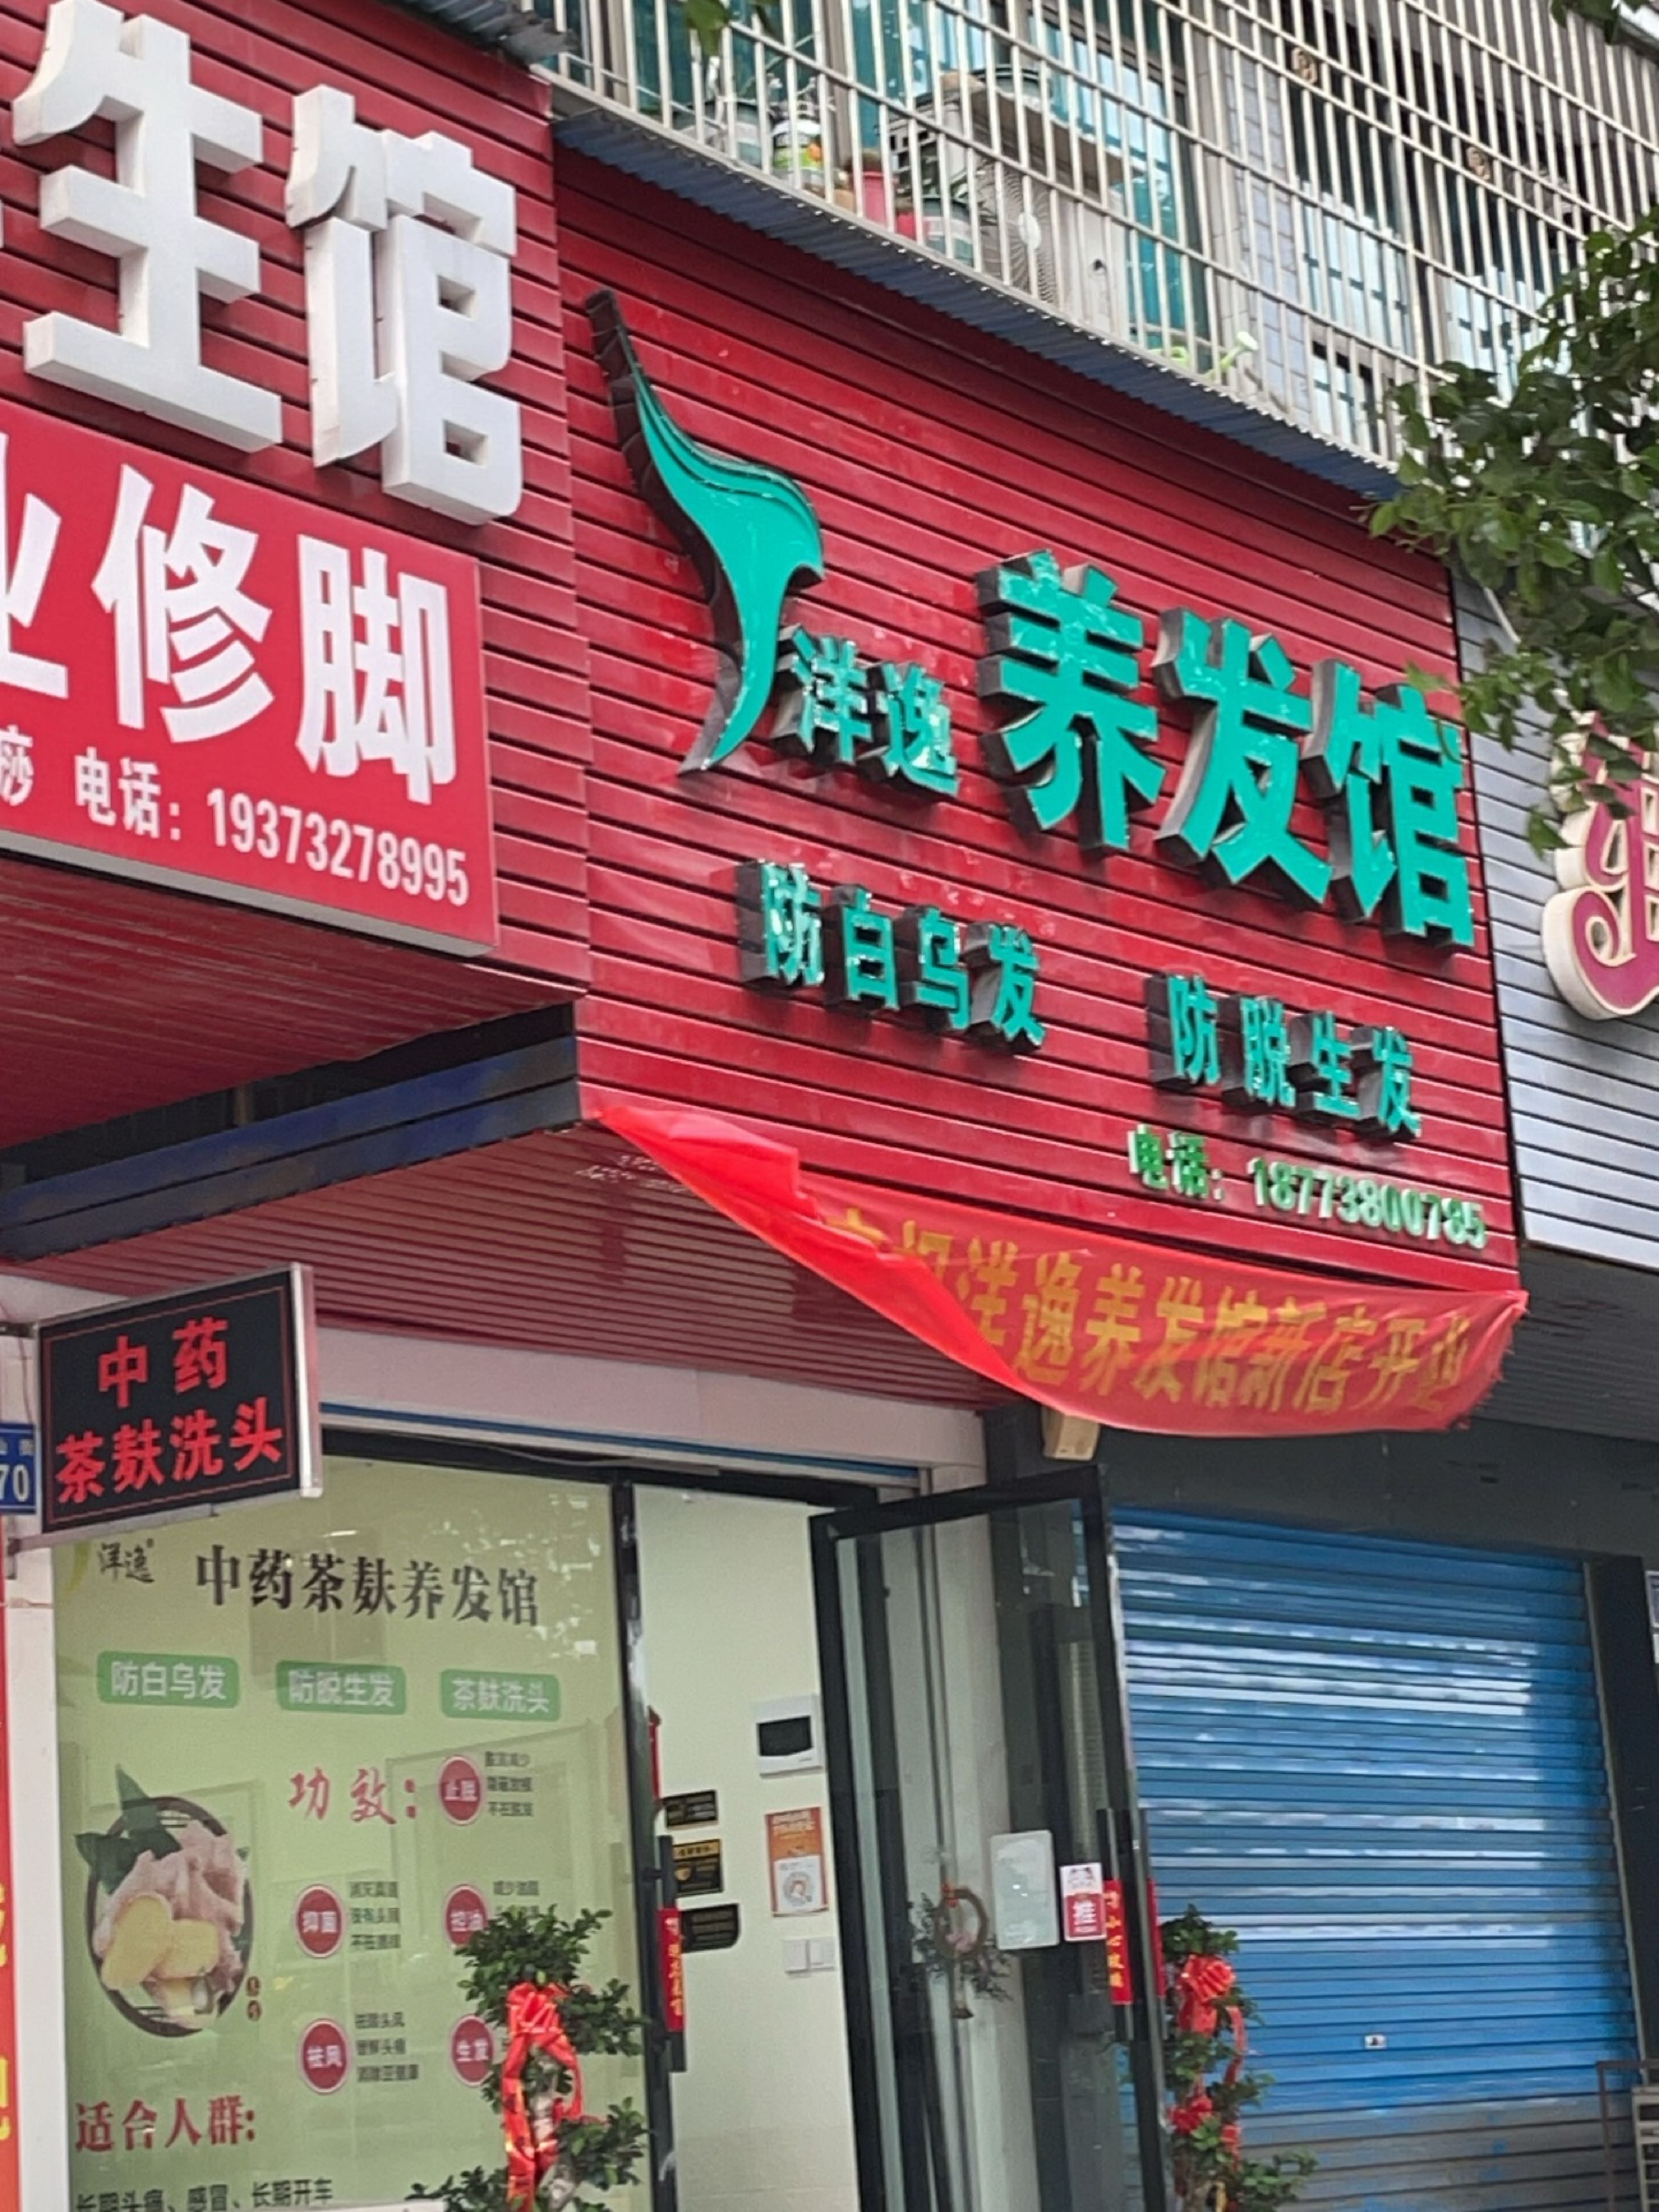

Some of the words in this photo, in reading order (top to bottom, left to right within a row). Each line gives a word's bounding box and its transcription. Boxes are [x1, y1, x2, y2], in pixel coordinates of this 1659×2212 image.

[13, 0, 523, 524] 生馆
[987, 549, 1475, 947] 养发馆
[757, 860, 1046, 1046] 防白乌发
[1164, 974, 1422, 1138] 防脱生发
[98, 1316, 230, 1407] 中药
[826, 1208, 1470, 1414] 洋逸养发馆新店开业
[55, 1397, 283, 1503] 茶麸洗头
[196, 1544, 539, 1627] 中药茶麸养发馆
[111, 1661, 227, 1701] 防白乌发
[287, 1667, 395, 1708] 防脱生发
